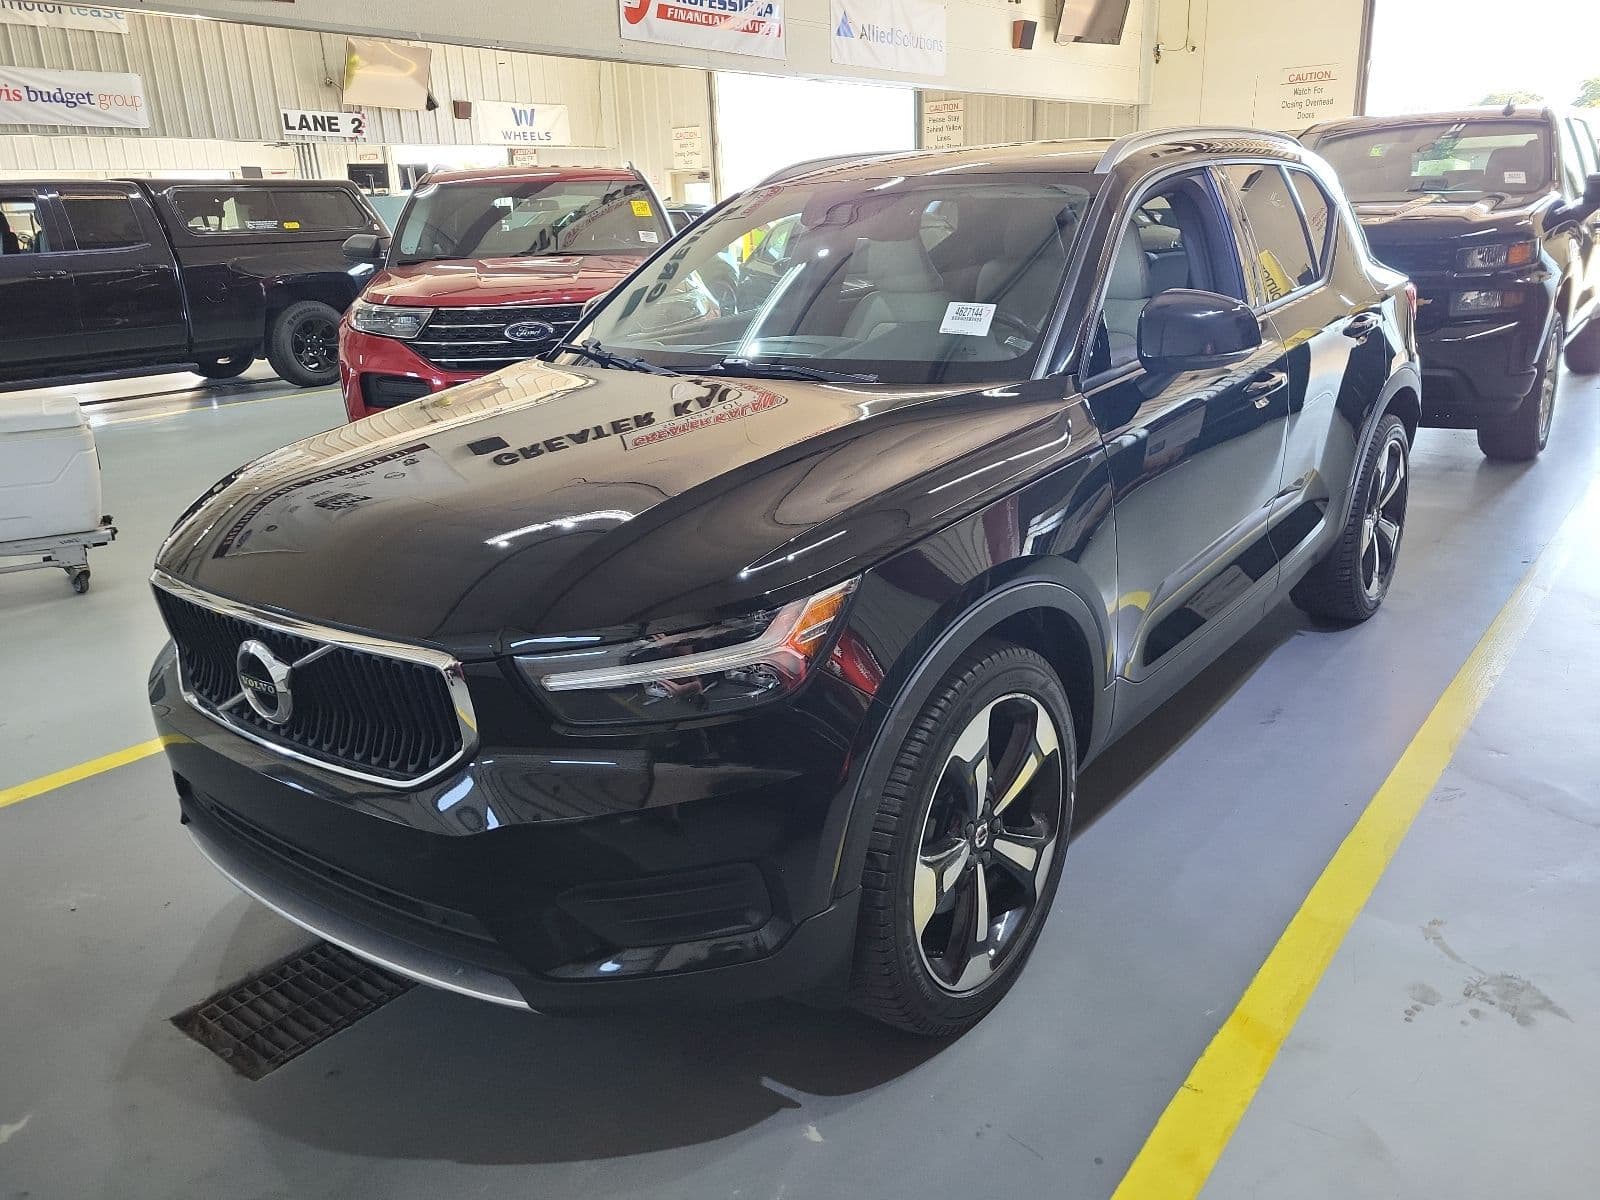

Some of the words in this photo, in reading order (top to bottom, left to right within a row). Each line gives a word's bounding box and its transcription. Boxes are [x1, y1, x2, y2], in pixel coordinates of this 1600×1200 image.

[1288, 71, 1331, 83] CAUTION
[24, 86, 95, 108] budget
[98, 93, 142, 111] group
[283, 113, 340, 133] LANE
[350, 117, 363, 134] 2
[501, 130, 552, 141] WHEELS
[516, 325, 542, 337] Ford
[241, 675, 275, 694] VOLVO
